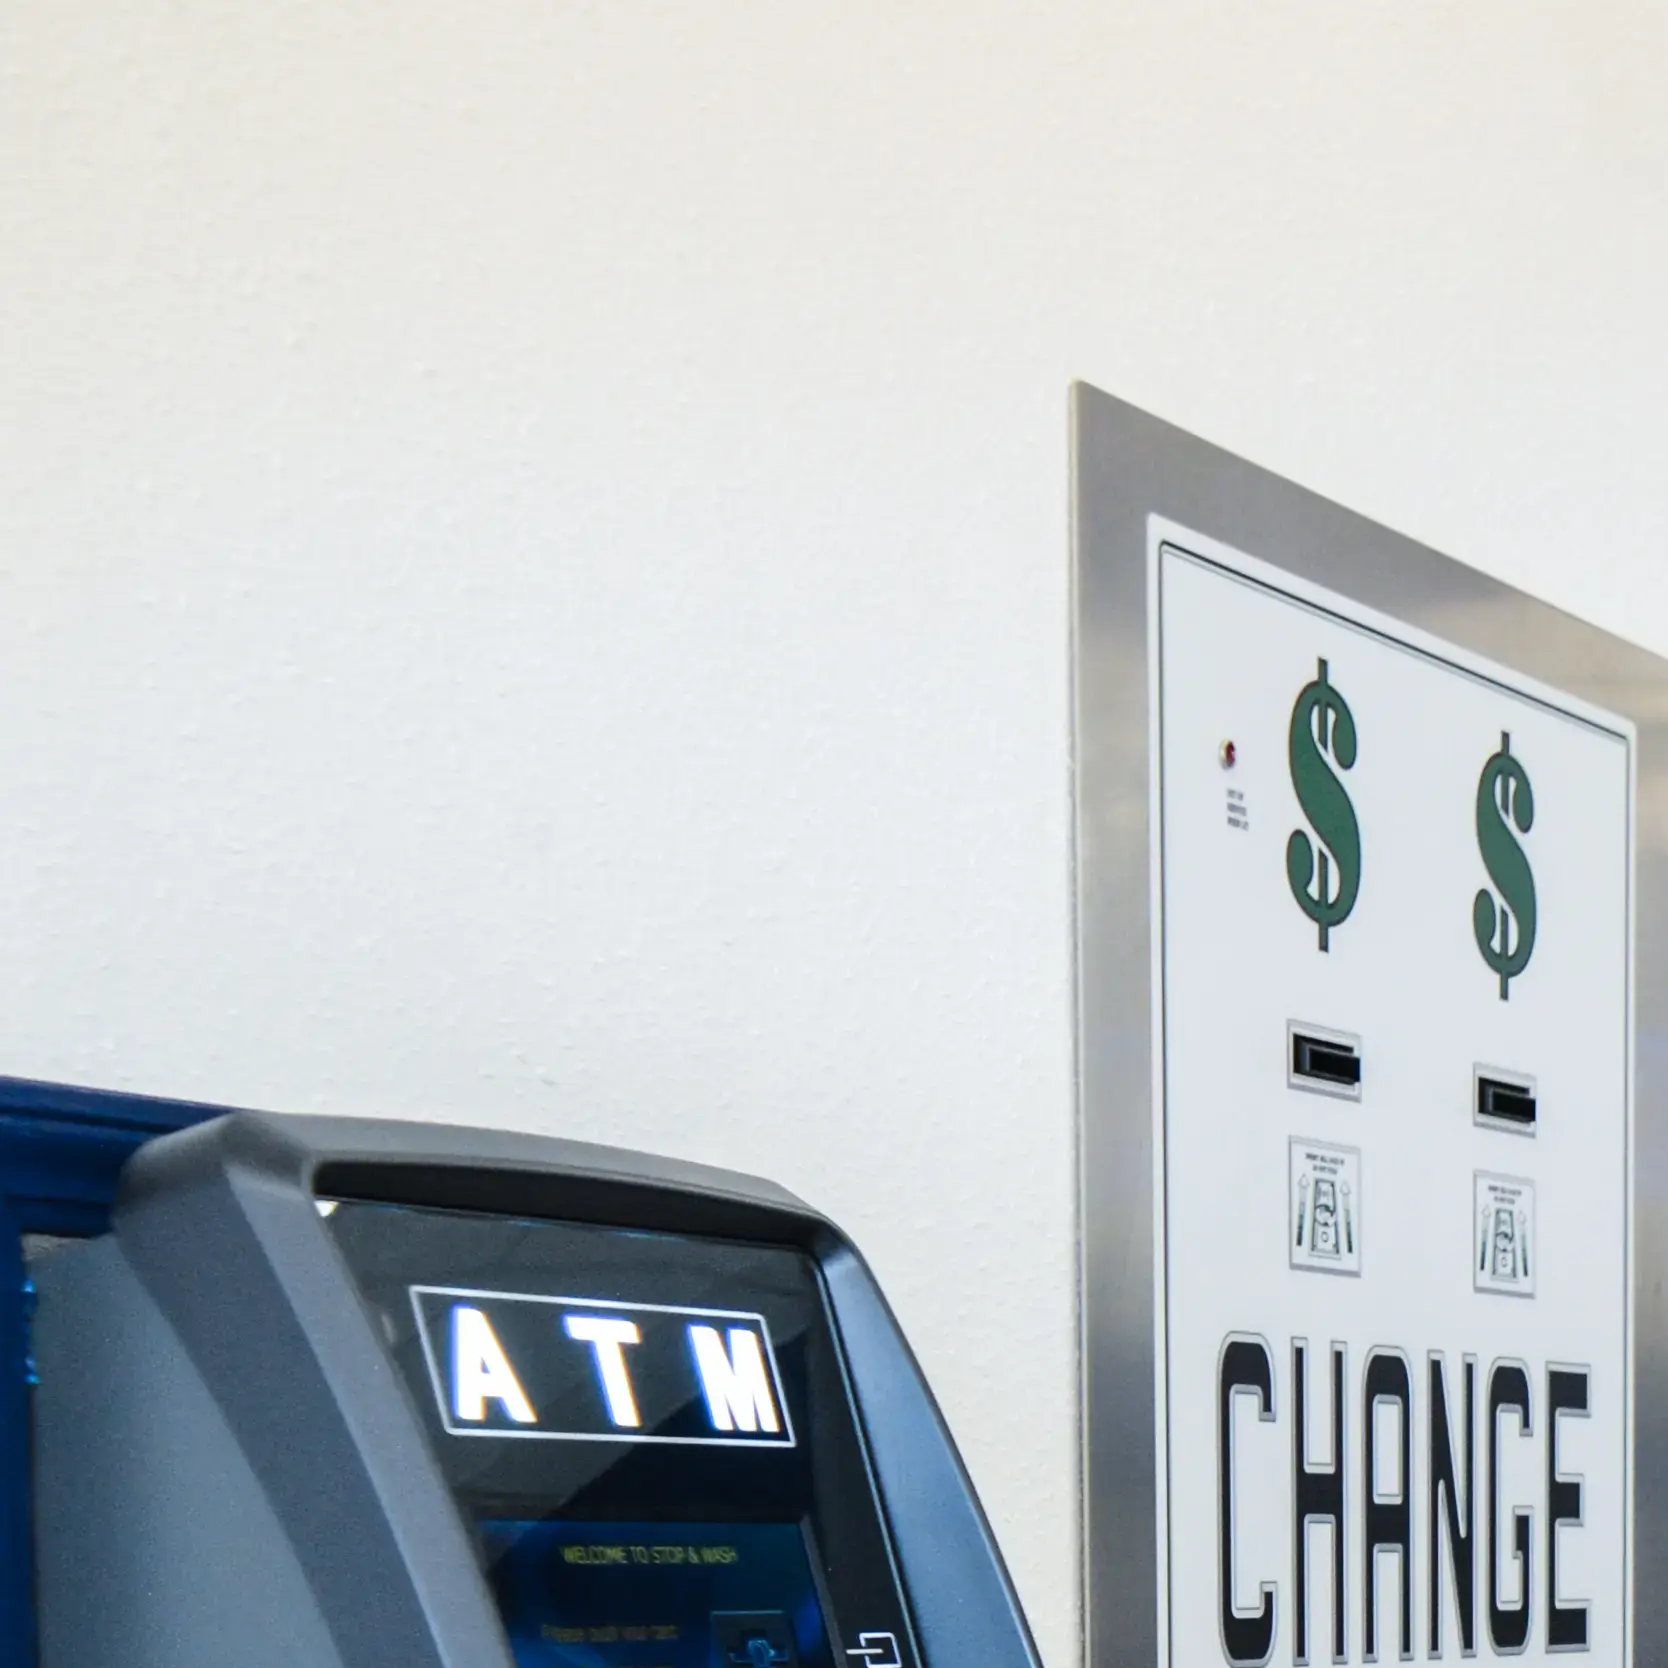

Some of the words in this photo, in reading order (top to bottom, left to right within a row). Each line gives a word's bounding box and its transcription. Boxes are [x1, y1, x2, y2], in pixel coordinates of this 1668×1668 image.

[1286, 656, 1361, 953] $
[1473, 730, 1537, 1001] $
[452, 1302, 781, 1434] ATM
[563, 1546, 628, 1565] WELCOME
[629, 1546, 650, 1565] TO
[653, 1546, 684, 1565] STOP
